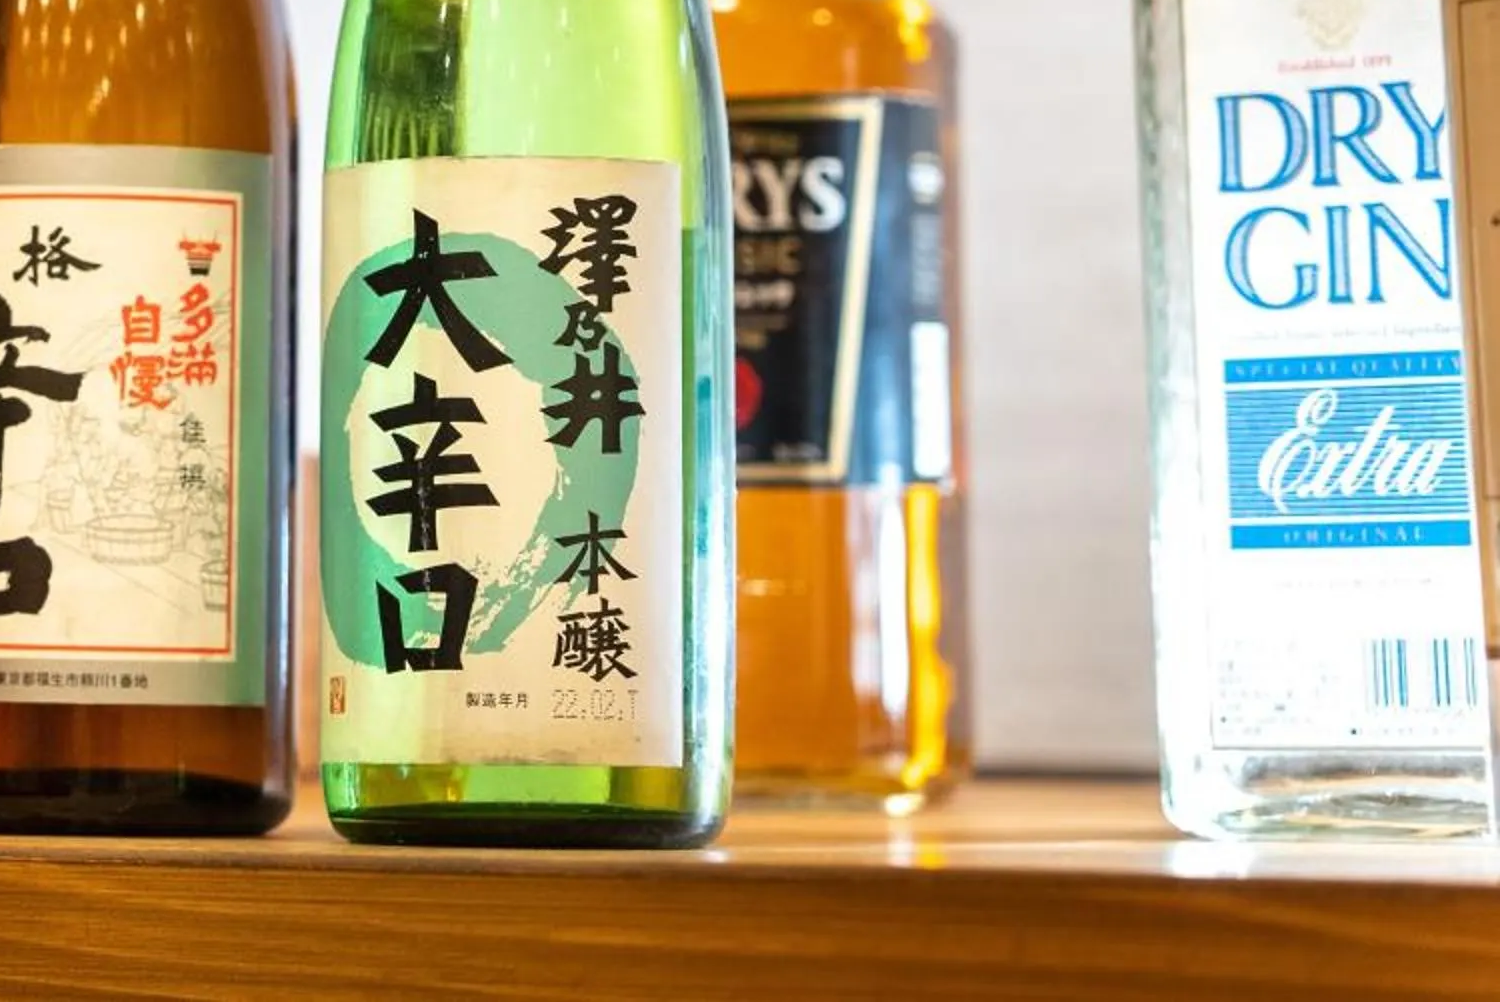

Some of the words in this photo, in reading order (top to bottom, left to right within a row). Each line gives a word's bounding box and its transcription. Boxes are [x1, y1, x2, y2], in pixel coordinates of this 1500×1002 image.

[1216, 81, 1445, 193] DRY
[733, 156, 846, 232] RYS
[1224, 198, 1452, 310] GIN
[538, 195, 646, 454] 澤乃井
[363, 208, 514, 674] 大辛口
[1258, 388, 1457, 514] Extra
[1284, 526, 1425, 544] ORIGINAL
[552, 510, 638, 682] 本醸
[466, 692, 529, 709] 製造年月
